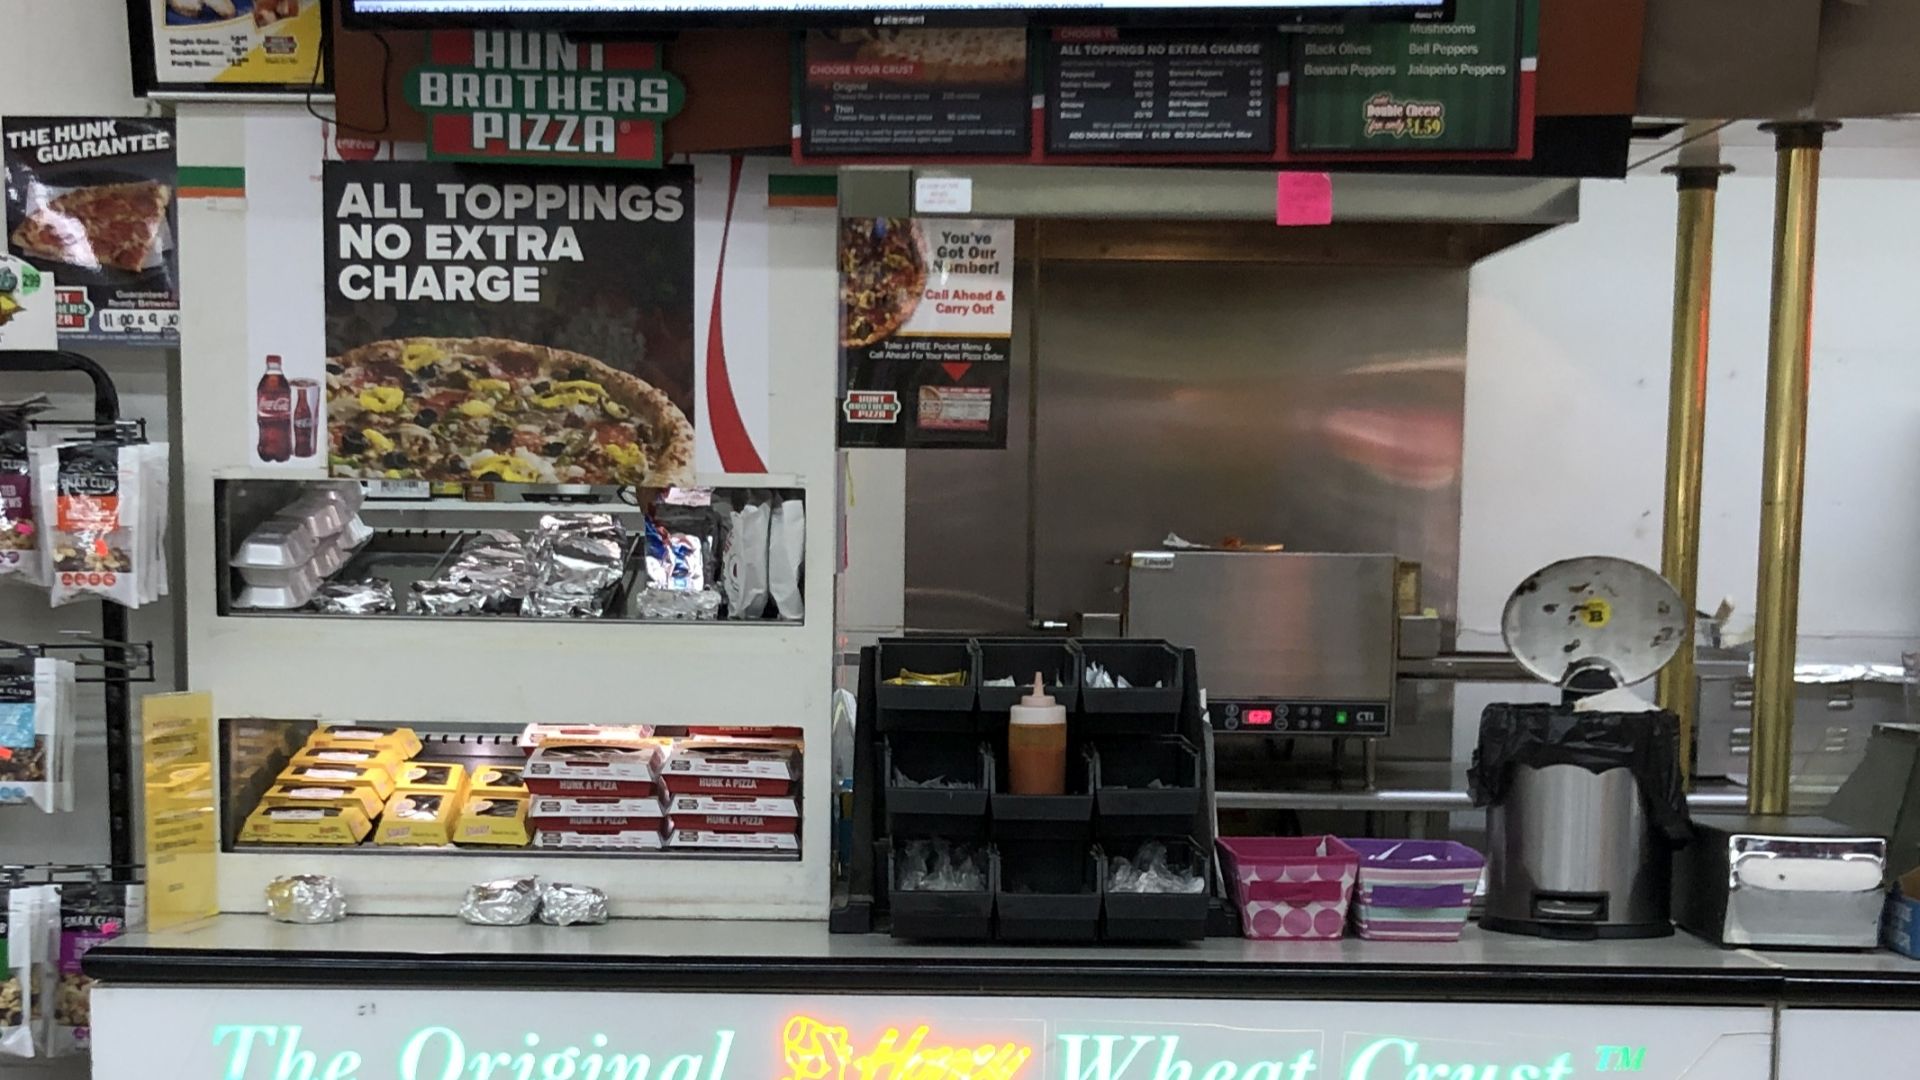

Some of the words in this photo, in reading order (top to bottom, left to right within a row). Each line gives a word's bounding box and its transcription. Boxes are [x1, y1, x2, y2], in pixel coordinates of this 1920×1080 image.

[1409, 23, 1477, 34] Mushrooms
[1060, 45, 1082, 56] ALL
[1084, 45, 1145, 56] TOPPINGS
[1147, 44, 1165, 55] NO
[1168, 44, 1207, 55] EXTRA
[1209, 44, 1260, 55] CHARGE
[1304, 44, 1337, 56] Black
[1338, 43, 1372, 55] Olives
[1409, 43, 1430, 55] Bell
[1432, 44, 1479, 57] Peppers
[809, 64, 851, 75] CHOOSE
[852, 64, 881, 75] YOUR
[882, 64, 915, 75] CRUST
[1304, 64, 1348, 76] Banana
[1349, 64, 1397, 77] Peppers
[1407, 63, 1458, 77] Jalapeño
[1460, 63, 1506, 77] Peppers
[419, 72, 669, 113] BROTHERS
[835, 104, 854, 114] Thin
[1367, 104, 1403, 117] Double
[1405, 103, 1441, 117] Cheese
[6, 127, 53, 149] THE
[54, 119, 118, 145] HUNK
[472, 112, 615, 153] PIZZA
[37, 131, 171, 164] GUARANTEE
[336, 183, 424, 219] ALL
[437, 183, 685, 222] TOPPINGS
[339, 223, 412, 260] NO
[426, 225, 585, 262] EXTRA
[942, 231, 992, 245] You've
[937, 246, 964, 259] Got
[968, 246, 997, 259] Our
[338, 264, 541, 302] CHARGE
[925, 289, 949, 300] Call
[953, 289, 993, 300] Ahead
[995, 290, 1006, 301] &
[935, 302, 970, 316] Carry
[972, 303, 994, 314] Out
[911, 341, 931, 350] FREE
[560, 781, 584, 790] HUNK
[593, 782, 618, 791] PIZZA
[700, 777, 723, 788] HUNK
[732, 778, 757, 789] PIZZA
[1594, 1044, 1647, 1072] TM
